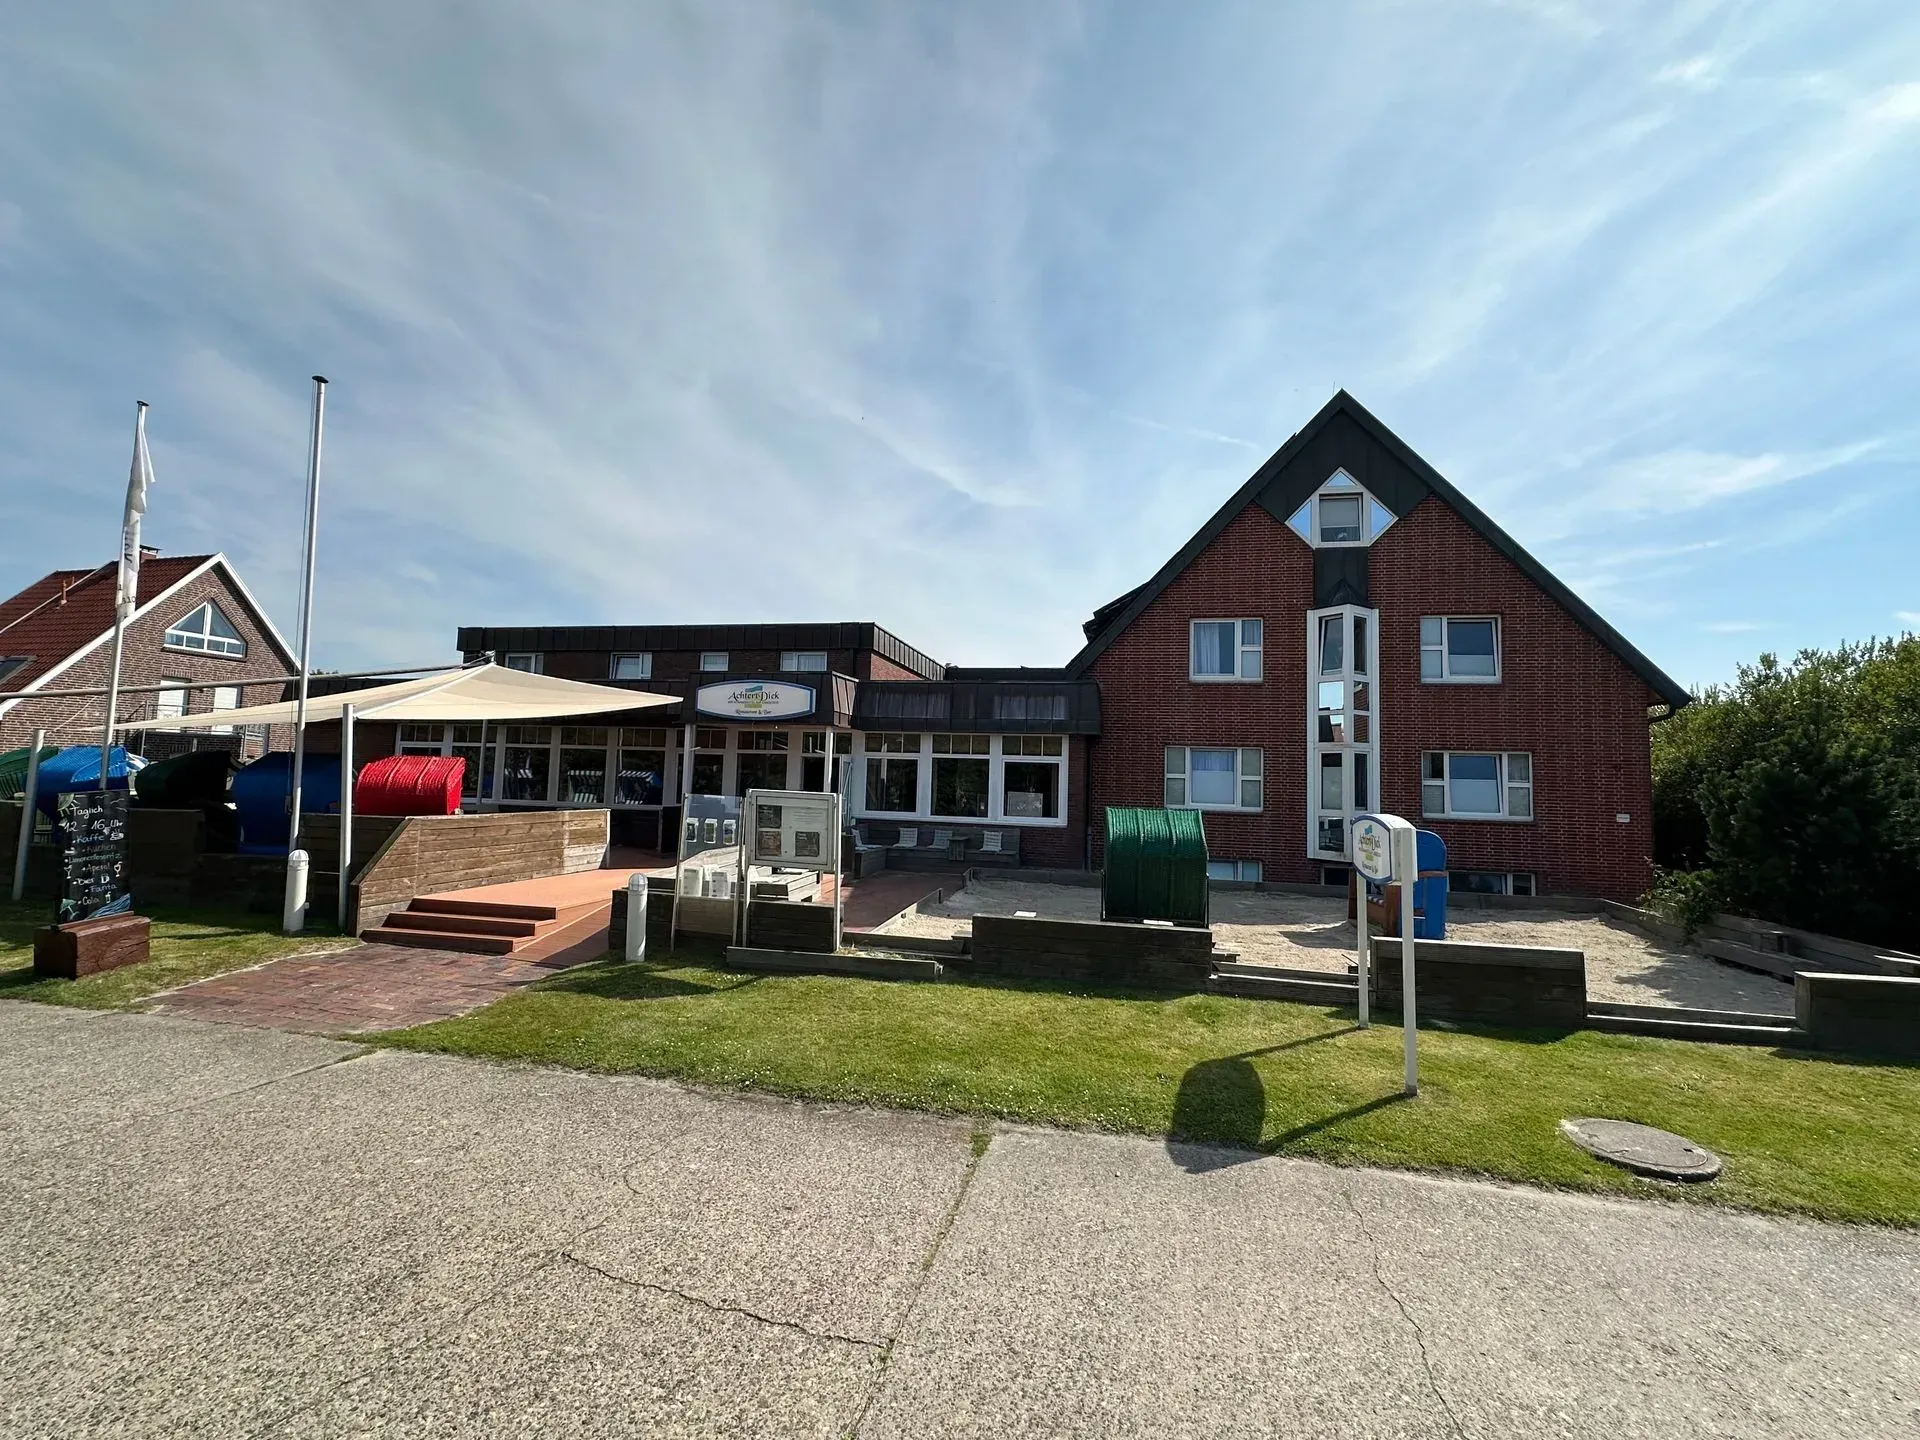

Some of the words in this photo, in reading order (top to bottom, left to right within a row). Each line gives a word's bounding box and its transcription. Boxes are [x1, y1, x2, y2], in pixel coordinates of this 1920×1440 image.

[759, 691, 779, 702] Diek
[64, 821, 78, 832] 12
[91, 818, 106, 830] 16
[87, 862, 111, 874] Aperol
[89, 884, 117, 892] Fanta
[82, 896, 100, 906] Cola
